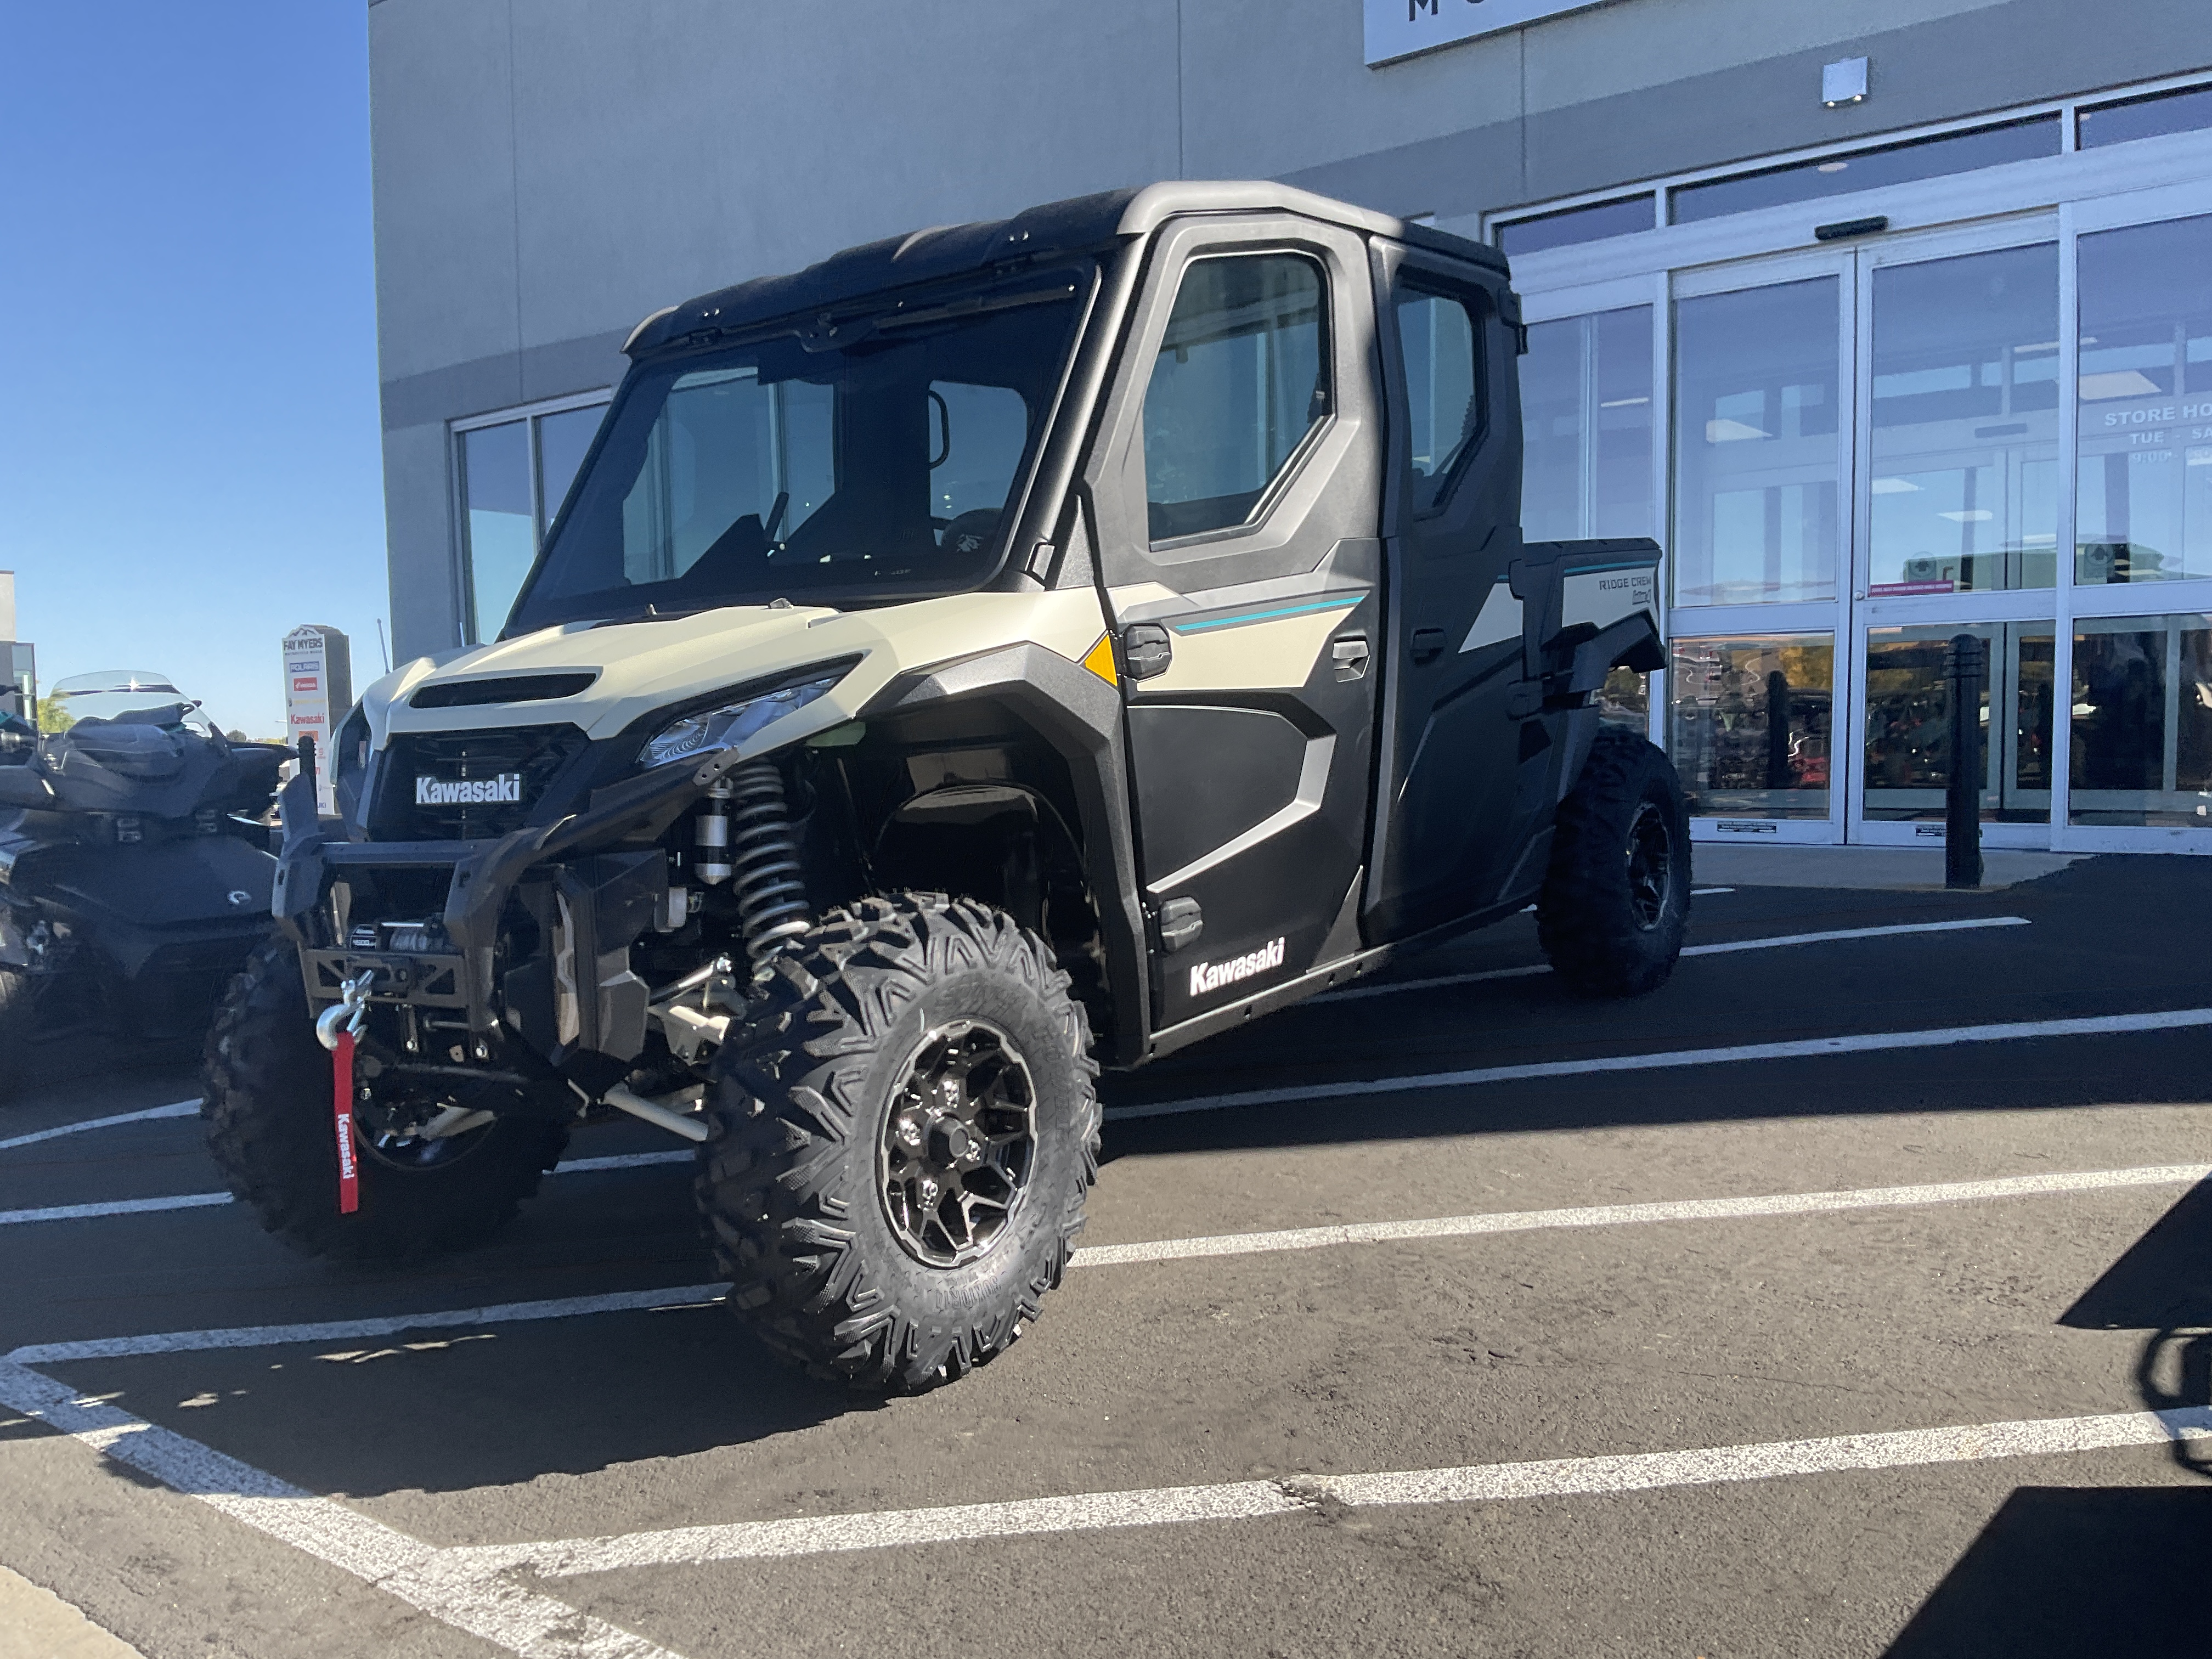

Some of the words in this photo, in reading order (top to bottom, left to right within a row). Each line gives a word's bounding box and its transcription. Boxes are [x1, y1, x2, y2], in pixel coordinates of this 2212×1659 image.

[2104, 407, 2175, 426] STORE
[2129, 431, 2164, 444] TUE
[1599, 578, 1629, 590] RIDGE
[1631, 576, 1651, 587] CREW
[284, 639, 296, 651] FAY
[297, 637, 323, 650] MYERS
[291, 713, 325, 725] Kawasaki
[416, 774, 520, 804] Kawasaki
[1189, 936, 1285, 997] Kawasaki
[337, 1113, 354, 1179] Kawasaki
